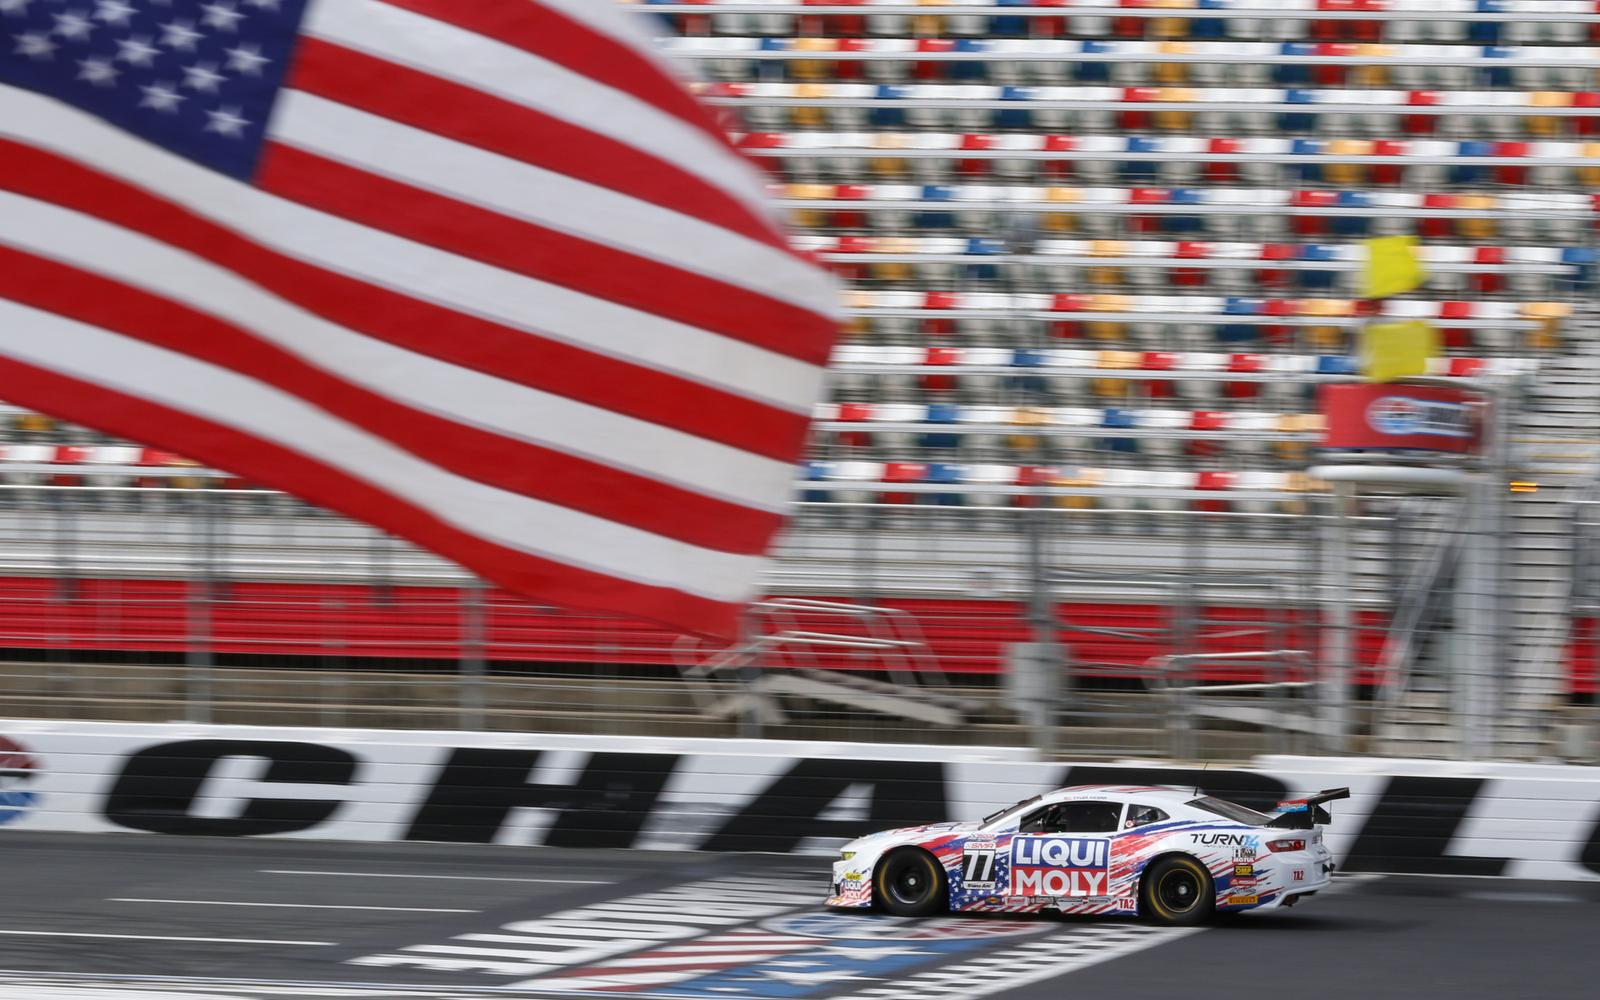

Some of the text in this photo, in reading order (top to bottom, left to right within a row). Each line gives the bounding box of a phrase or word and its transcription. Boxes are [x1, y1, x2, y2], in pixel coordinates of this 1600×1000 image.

[1016, 838, 1105, 867] LIQUI
[964, 850, 995, 881] 77
[1293, 870, 1304, 880] TA2
[845, 882, 860, 890] LIQUI
[1016, 869, 1106, 896] MOLY
[845, 891, 860, 899] MOLY
[1118, 899, 1134, 909] TA2
